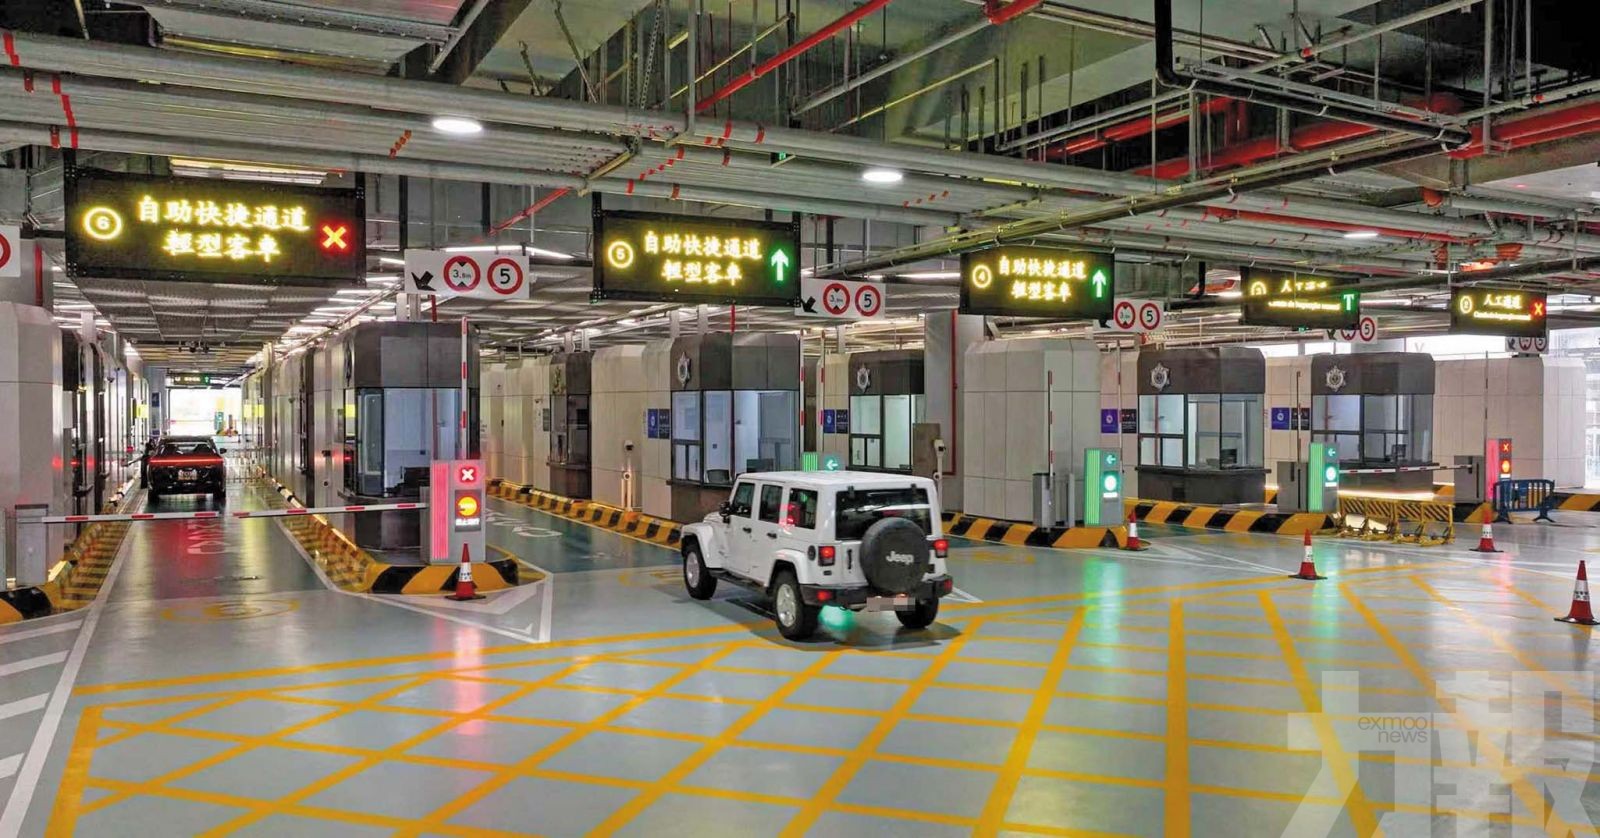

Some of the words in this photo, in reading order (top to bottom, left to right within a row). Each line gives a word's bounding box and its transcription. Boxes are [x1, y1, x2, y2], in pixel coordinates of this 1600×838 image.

[138, 195, 309, 231] 自助快捷通道
[98, 216, 110, 229] 6
[164, 230, 280, 261] 輕型客車
[644, 231, 762, 259] 自助快捷通道
[616, 248, 625, 260] 5
[662, 260, 742, 285] 輕型客車
[999, 256, 1086, 279] 自助快捷通道
[500, 268, 511, 285] 5
[978, 270, 986, 281] 4
[864, 294, 872, 308] 5
[1146, 310, 1154, 323] 5
[1364, 324, 1370, 335] 5
[886, 551, 914, 565] Jeep
